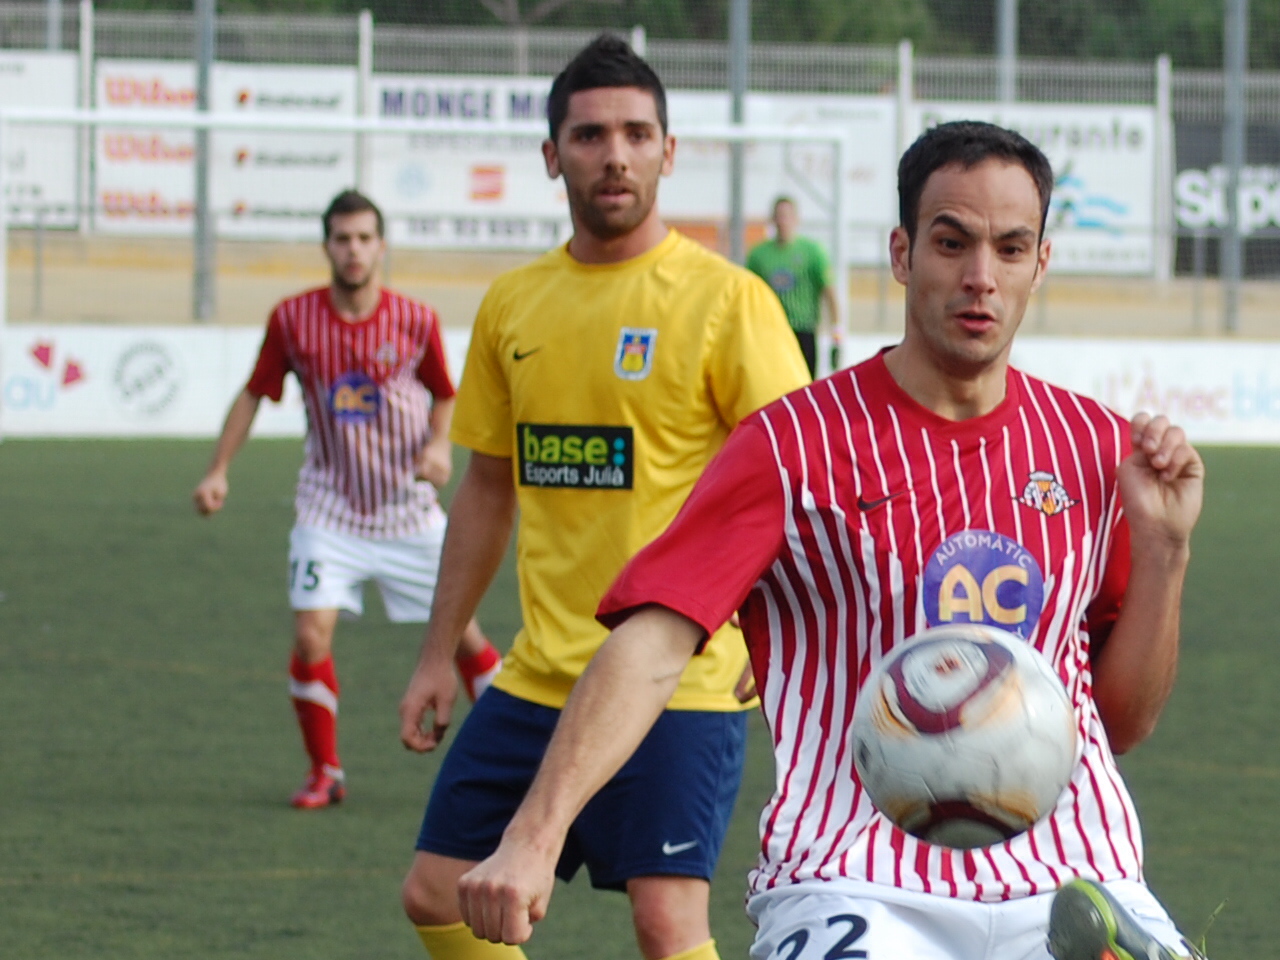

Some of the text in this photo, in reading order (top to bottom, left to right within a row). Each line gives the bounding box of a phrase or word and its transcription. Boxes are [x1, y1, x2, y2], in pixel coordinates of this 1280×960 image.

[104, 77, 197, 107] Wilso
[102, 135, 197, 163] Wilso
[101, 191, 197, 220] Wilso
[524, 461, 580, 487] Esports
[290, 560, 320, 591] 15
[938, 563, 1029, 625] AC
